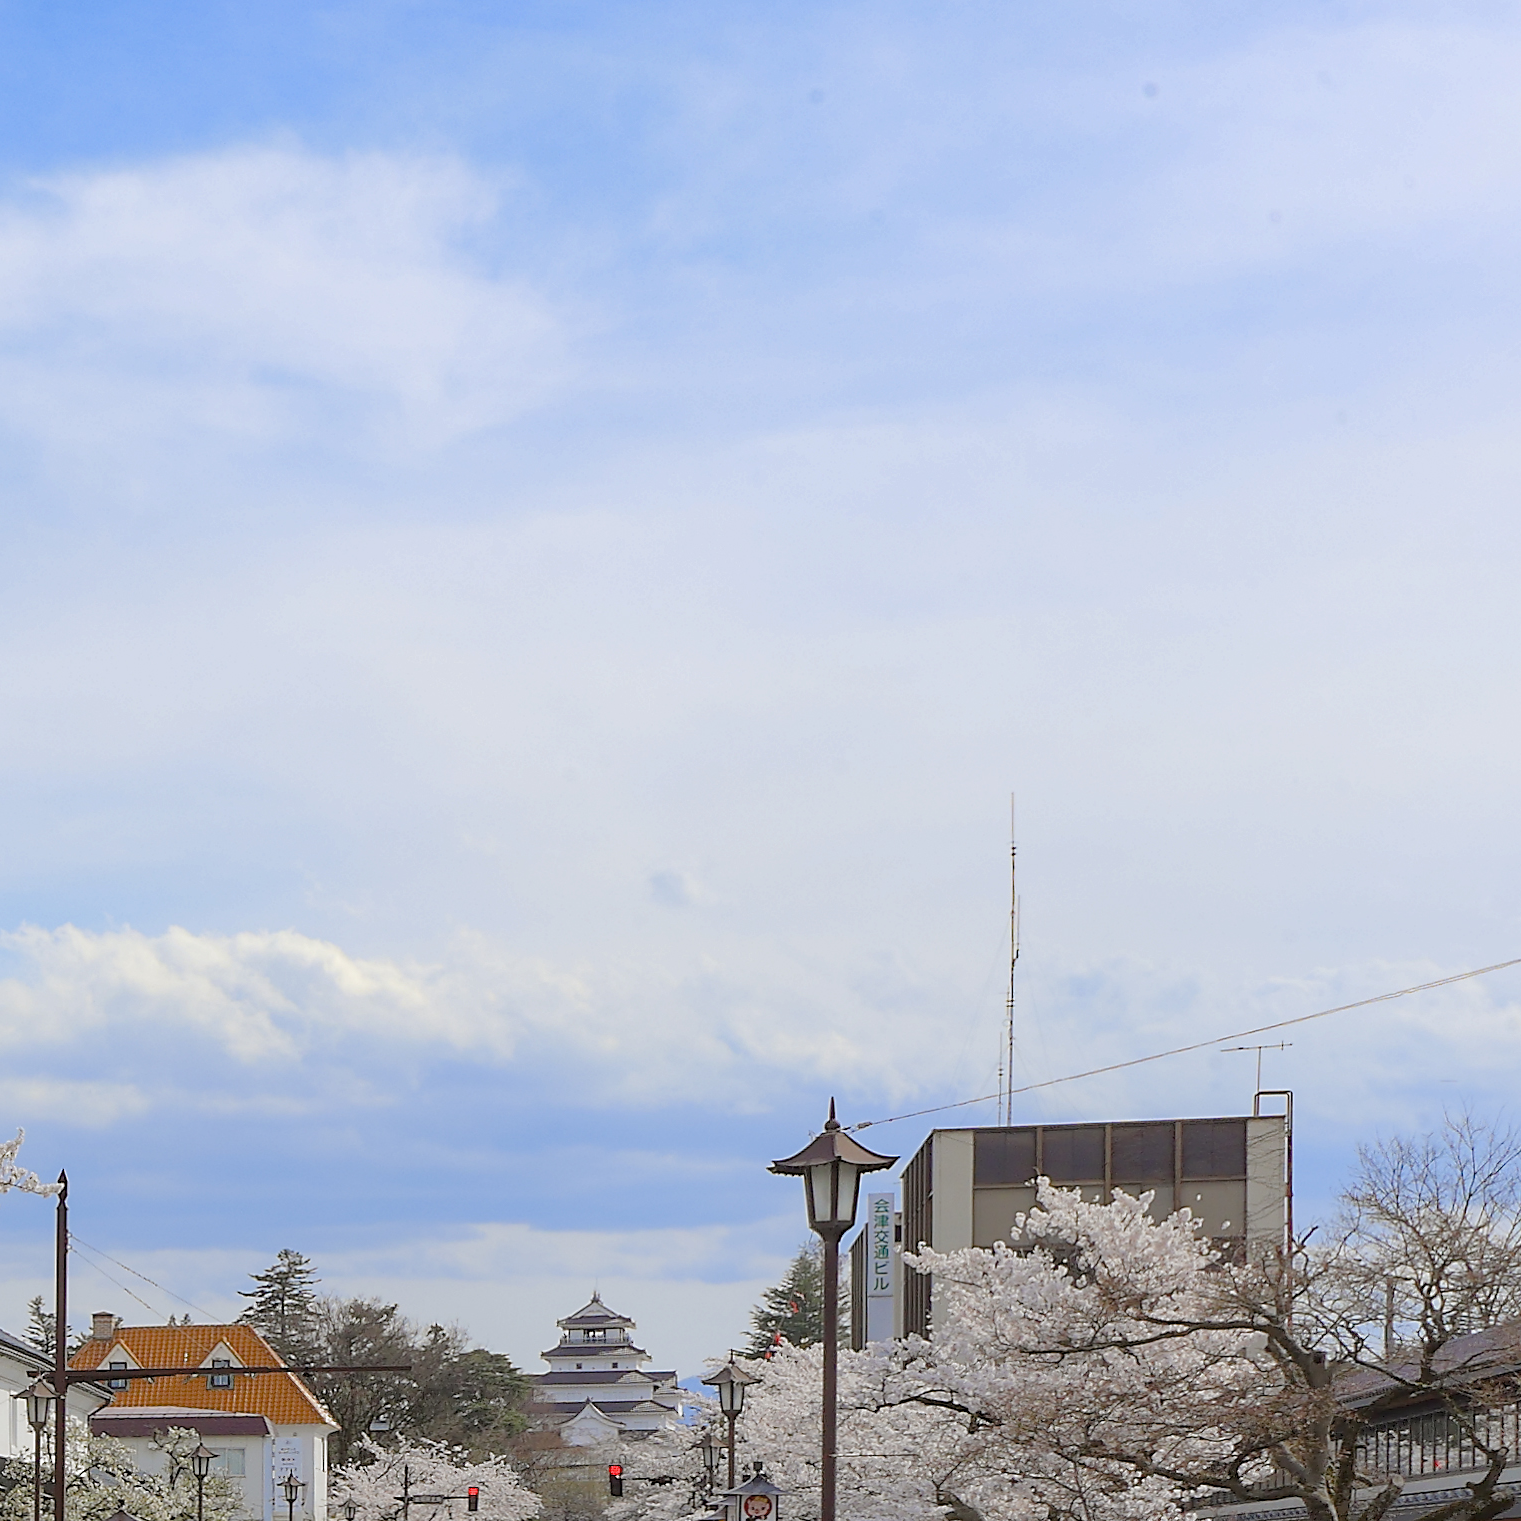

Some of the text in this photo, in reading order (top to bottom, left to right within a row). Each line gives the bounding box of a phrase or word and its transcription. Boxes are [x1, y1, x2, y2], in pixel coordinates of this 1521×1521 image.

[874, 1198, 890, 1291] 会津交通ビル
